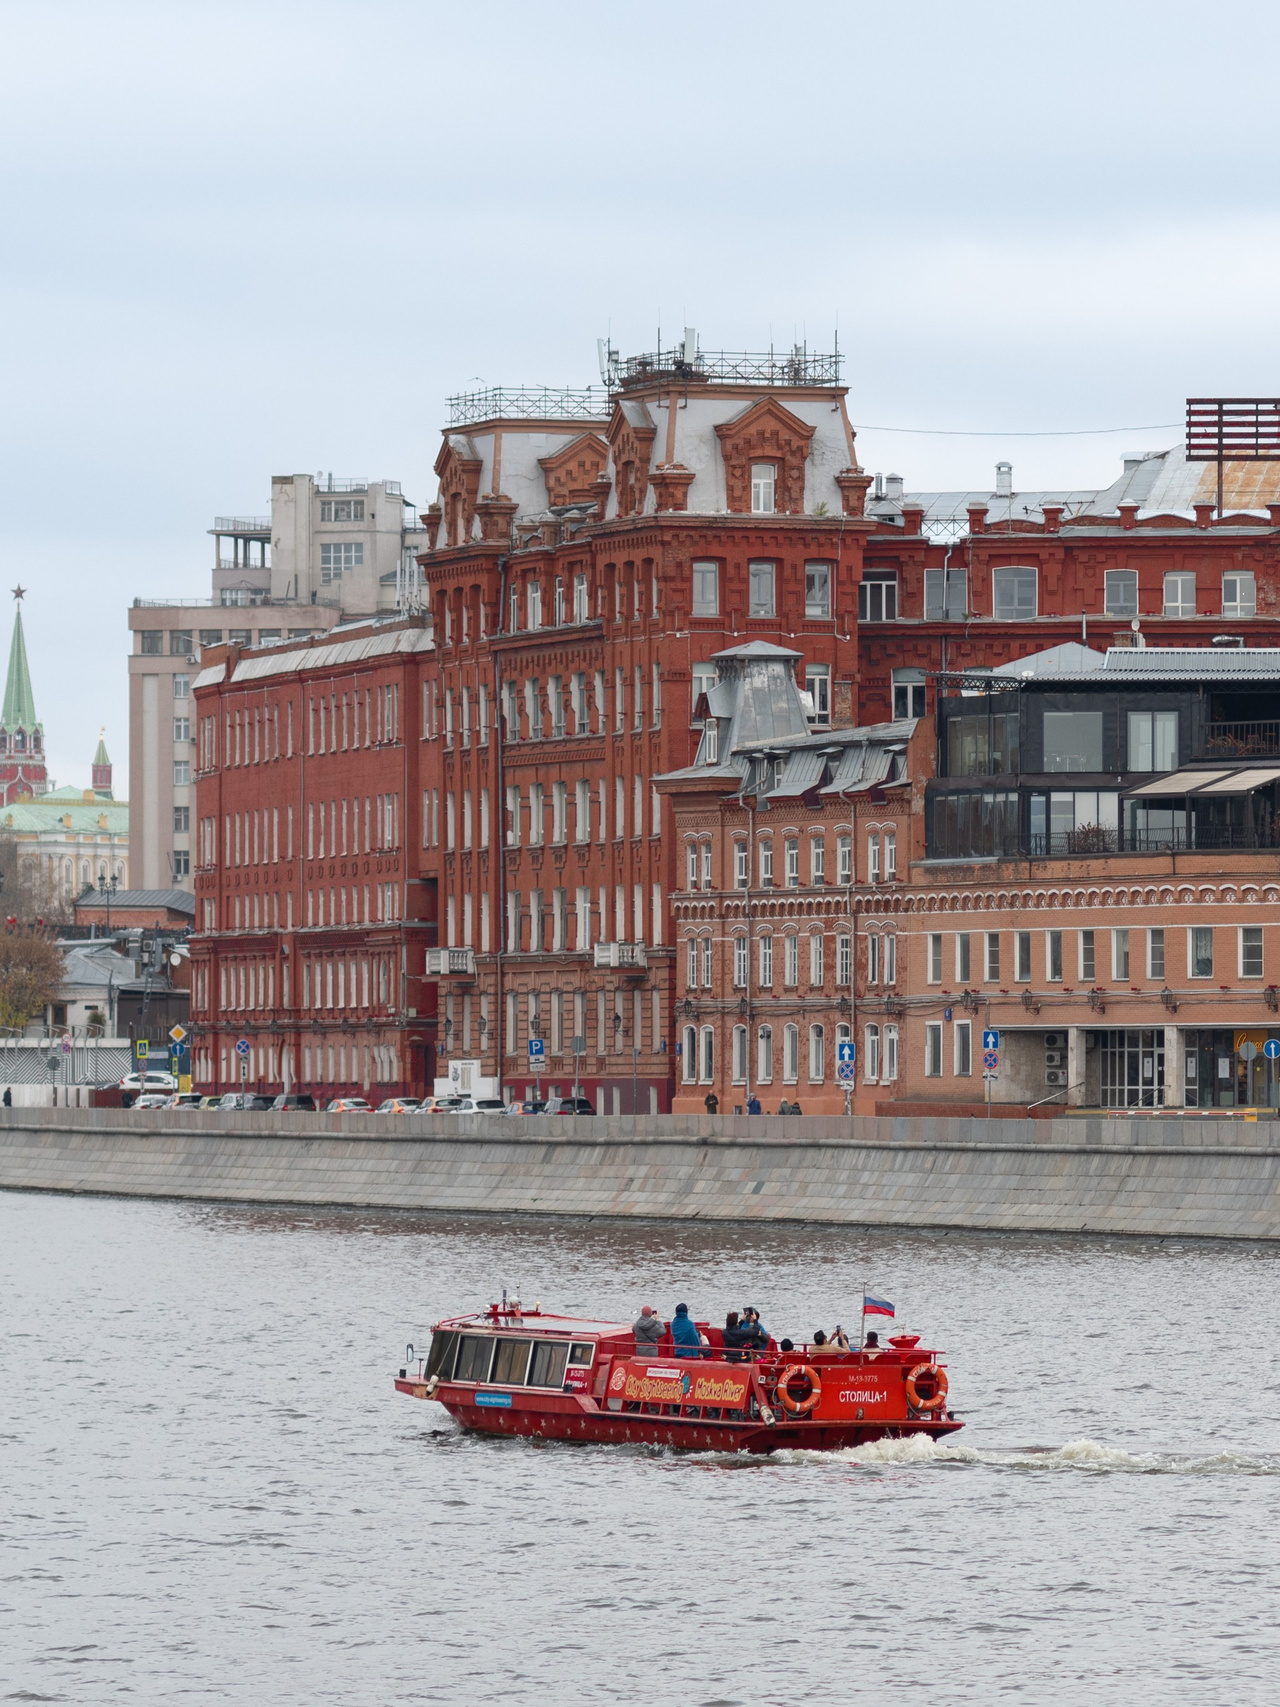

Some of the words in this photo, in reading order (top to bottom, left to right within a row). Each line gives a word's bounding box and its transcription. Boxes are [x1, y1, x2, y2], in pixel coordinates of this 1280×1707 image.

[532, 1041, 541, 1054] P
[625, 1374, 641, 1398] City
[640, 1377, 684, 1403] Sightseeing
[695, 1377, 723, 1401] Moskva
[722, 1379, 745, 1402] River
[839, 1391, 887, 1403] СТОЛИЦА-1
